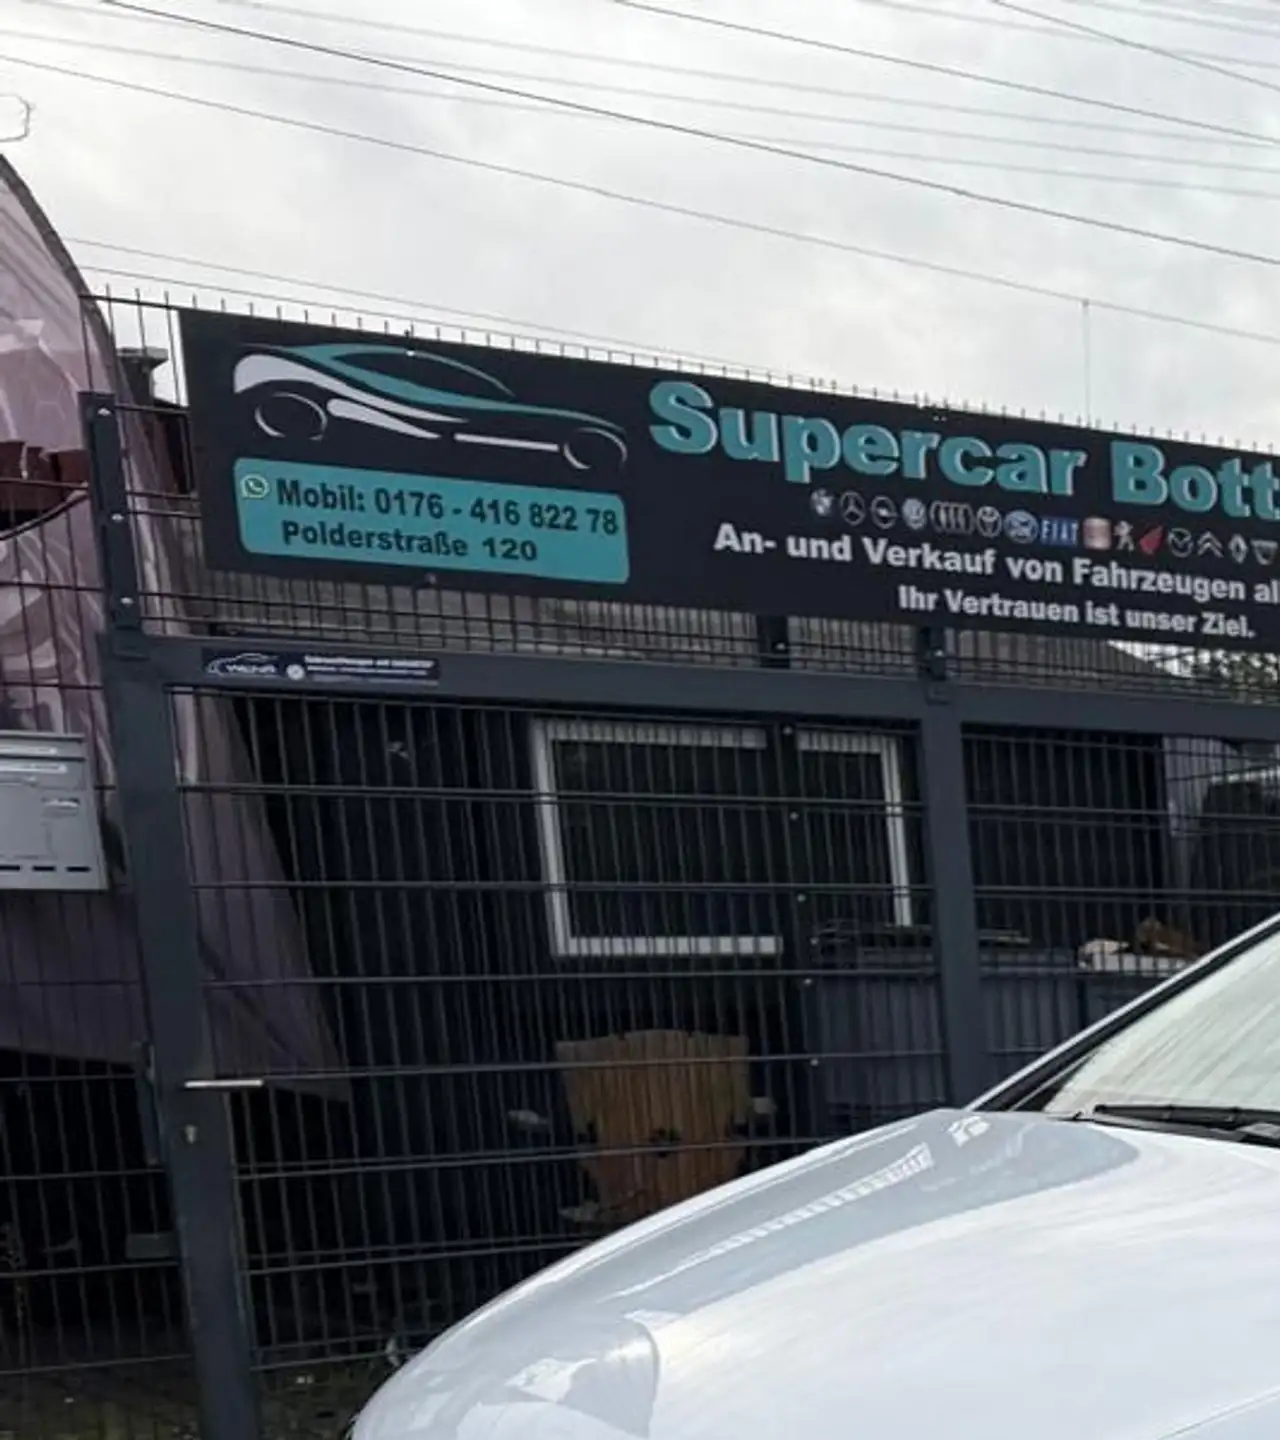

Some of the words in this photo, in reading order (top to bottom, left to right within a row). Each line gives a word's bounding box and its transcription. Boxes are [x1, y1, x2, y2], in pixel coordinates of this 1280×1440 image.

[649, 381, 1088, 496] Supercar
[276, 477, 365, 513] Mobil:
[374, 487, 444, 519] 0176
[470, 497, 521, 526] 416
[529, 502, 578, 532] 822
[585, 507, 619, 535] 78
[1042, 519, 1079, 546] FIAT
[281, 519, 468, 557] Polderstraße
[482, 536, 538, 561] 120
[713, 522, 777, 554] An-
[786, 534, 852, 562] und
[862, 536, 996, 575] Verkauf
[1005, 556, 1063, 582] von
[1072, 557, 1246, 602] Fahrzeugen
[898, 584, 939, 611] Ihr
[942, 588, 1079, 622] Vertrauen
[1086, 600, 1119, 626] ist
[1126, 608, 1198, 633] unser
[1202, 611, 1256, 638] Ziel.
